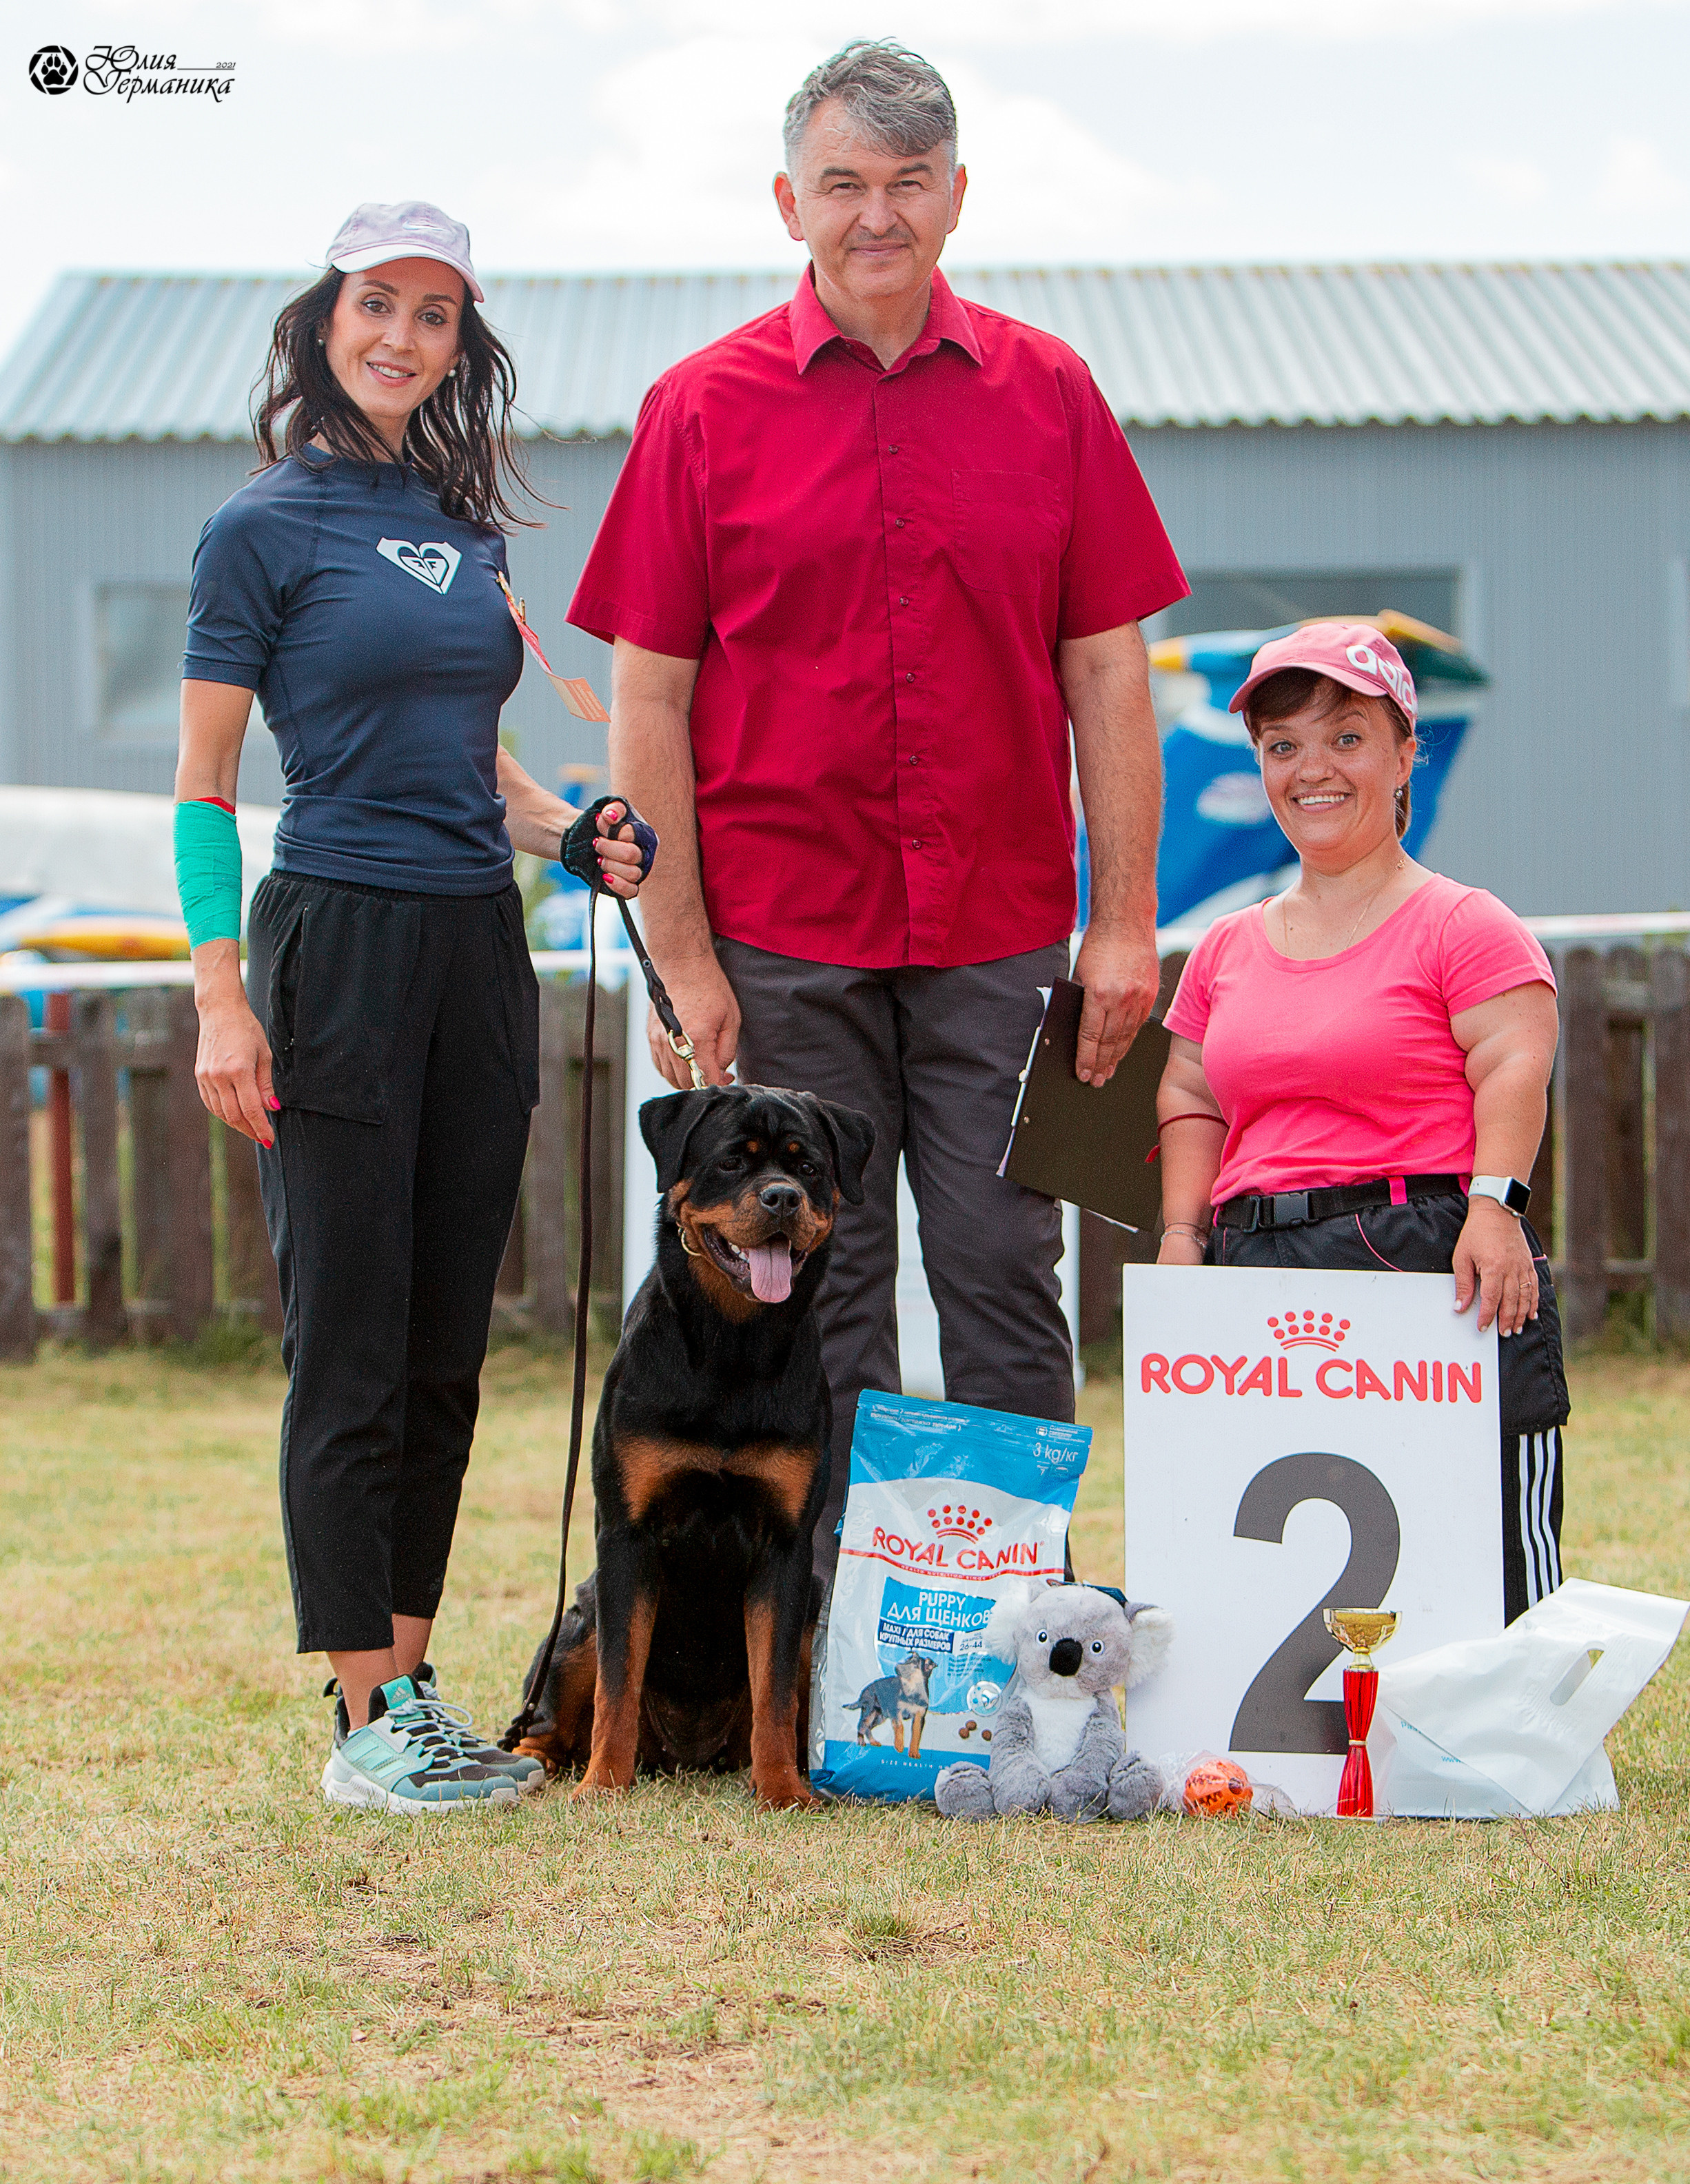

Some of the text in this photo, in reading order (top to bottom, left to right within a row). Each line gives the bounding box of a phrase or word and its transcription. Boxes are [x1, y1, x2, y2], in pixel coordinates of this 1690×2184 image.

[1141, 1352, 1483, 1403] ROYAL CANIN
[1032, 1442, 1041, 1457] 3
[873, 1526, 1038, 1571] ROYAL CANIN
[919, 1591, 966, 1611] PUPPY
[1228, 1451, 1401, 1755] 2
[887, 1602, 991, 1627] ДЛЯ ЩЕНКОВ
[879, 1631, 914, 1646] КРУПНЫХ
[915, 1637, 951, 1651] РАЗМЕРОВ
[883, 1622, 902, 1635] MAXI
[906, 1627, 924, 1638] ДЛЯ
[924, 1629, 950, 1641] СОБАК
[959, 1640, 982, 1651] 26-44
